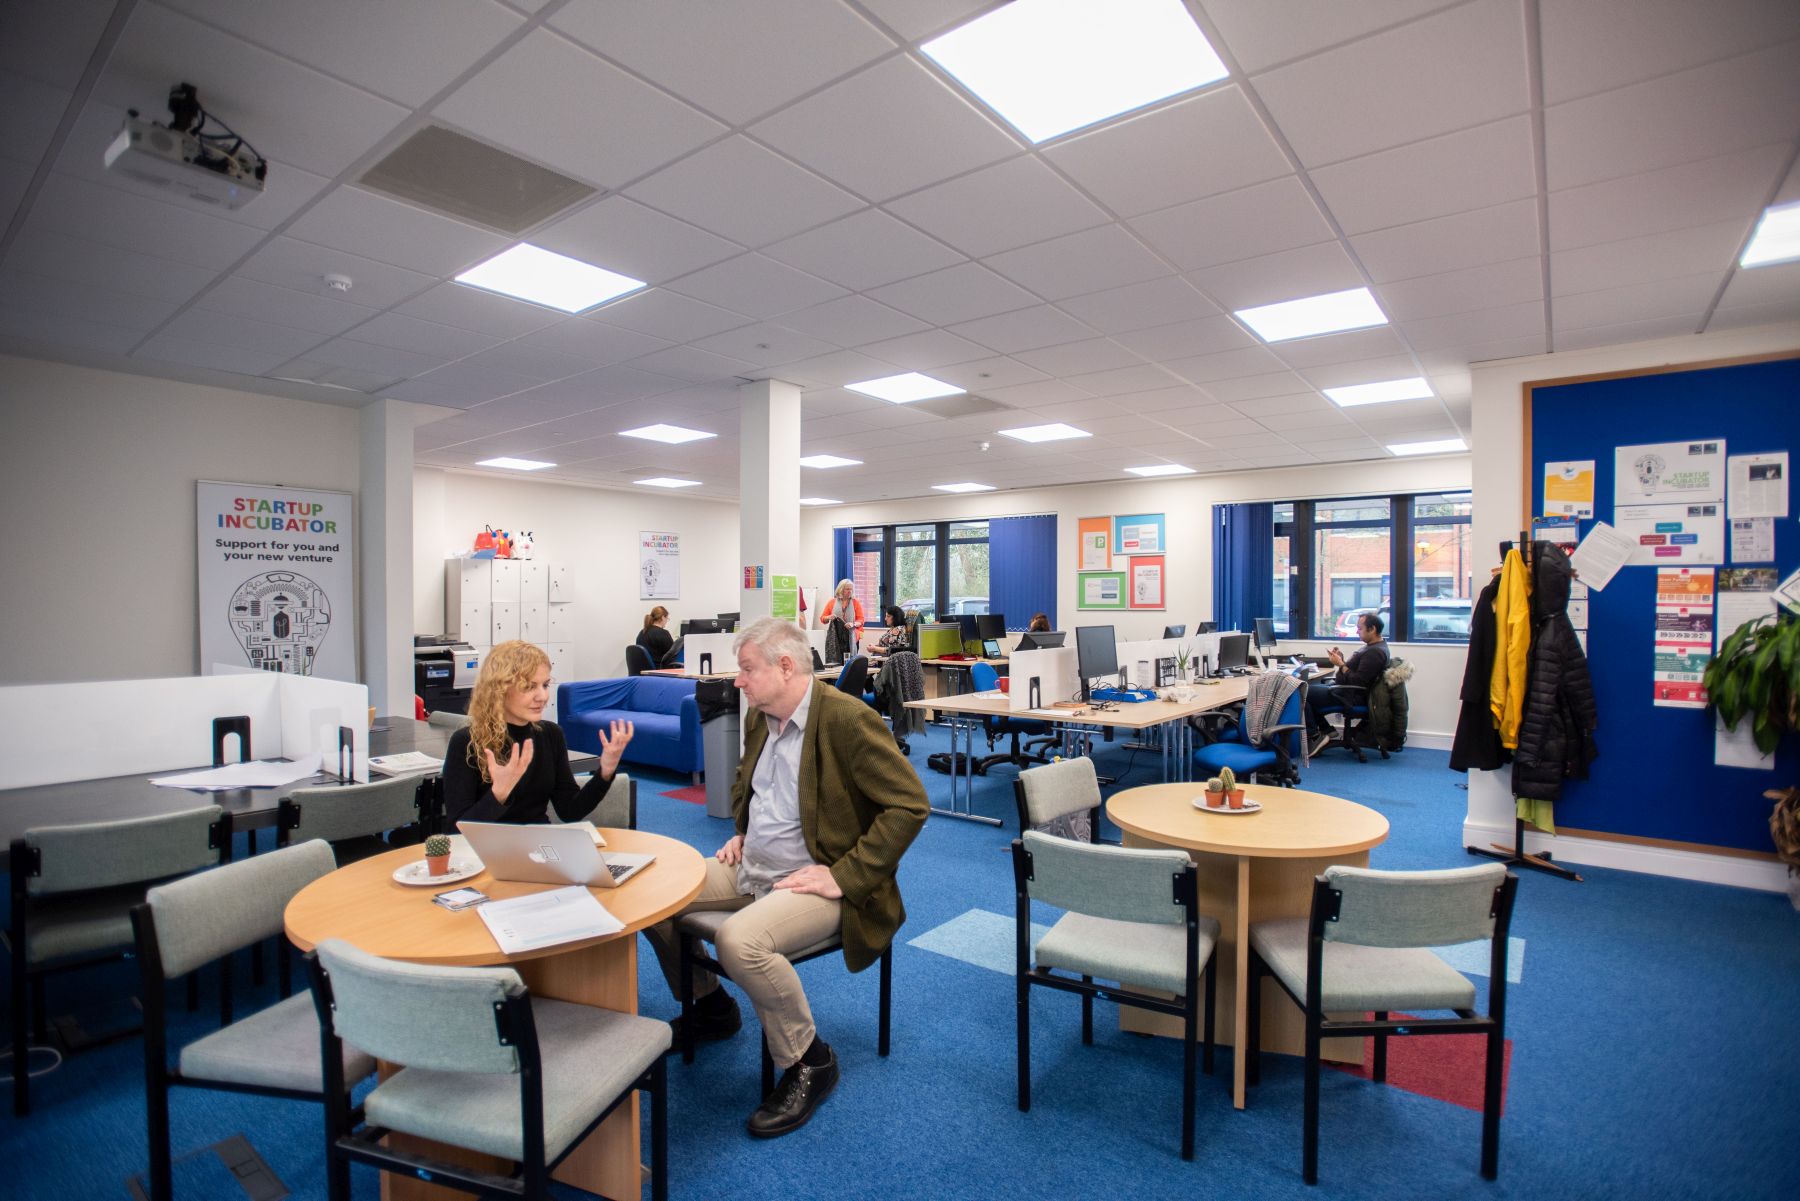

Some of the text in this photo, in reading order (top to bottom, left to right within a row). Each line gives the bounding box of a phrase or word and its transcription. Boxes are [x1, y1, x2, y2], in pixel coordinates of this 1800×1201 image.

[234, 498, 323, 516] STARTUP
[218, 514, 337, 533] INCUBATOR
[215, 538, 340, 552] Support for you and
[223, 552, 333, 563] your new venture
